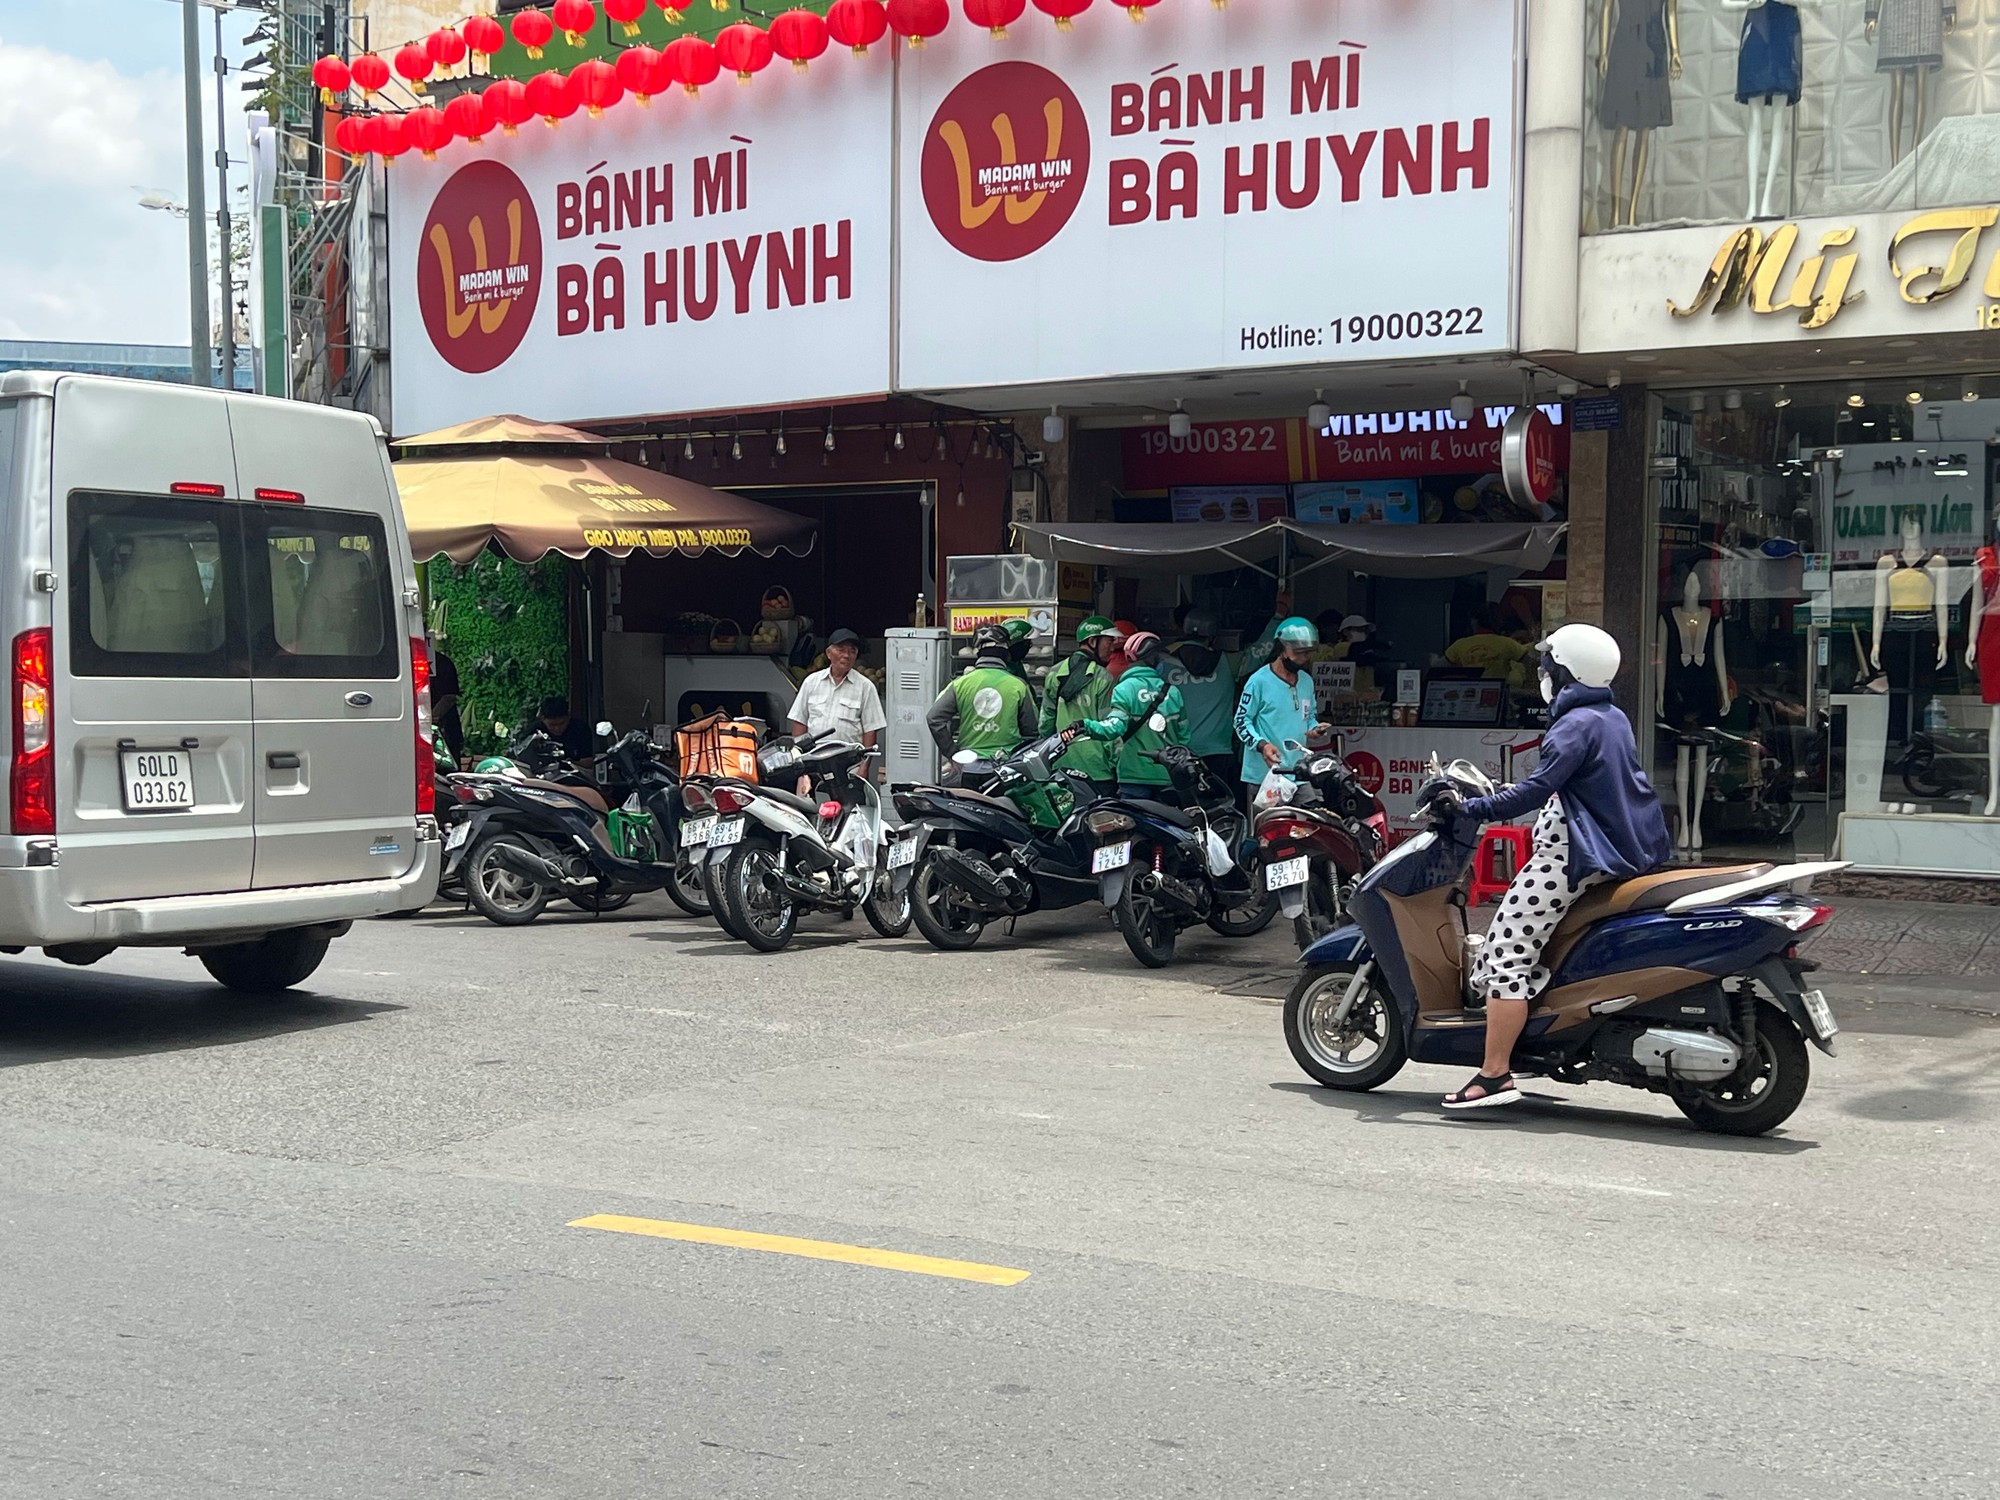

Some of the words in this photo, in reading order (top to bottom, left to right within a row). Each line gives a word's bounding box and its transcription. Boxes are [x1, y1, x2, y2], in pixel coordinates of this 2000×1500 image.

[1110, 63, 1265, 137] BÁNH
[1290, 40, 1367, 116] MÌ
[978, 163, 1036, 185] MADAM
[1041, 159, 1072, 178] WIN
[1108, 138, 1198, 227] BÀ
[1224, 117, 1490, 215] HUYNH
[557, 160, 673, 240] BÁNH
[694, 135, 752, 217] MÌ
[984, 182, 1009, 197] Banh
[1033, 179, 1066, 194] burger
[460, 268, 503, 291] MADAM
[506, 264, 529, 284] WIN
[557, 243, 625, 337] BÀ
[644, 219, 852, 326] HUYNH
[1241, 325, 1323, 352] Hotline:
[1330, 306, 1483, 345] 19000322
[1140, 426, 1277, 455] 19000322
[1335, 439, 1392, 464] Banh
[1430, 439, 1444, 460] &
[583, 528, 614, 546] GIAO
[972, 720, 1000, 733] Grab
[138, 755, 178, 777] 60LD
[134, 781, 188, 804] 033.62
[1683, 919, 1744, 931] LEAD
